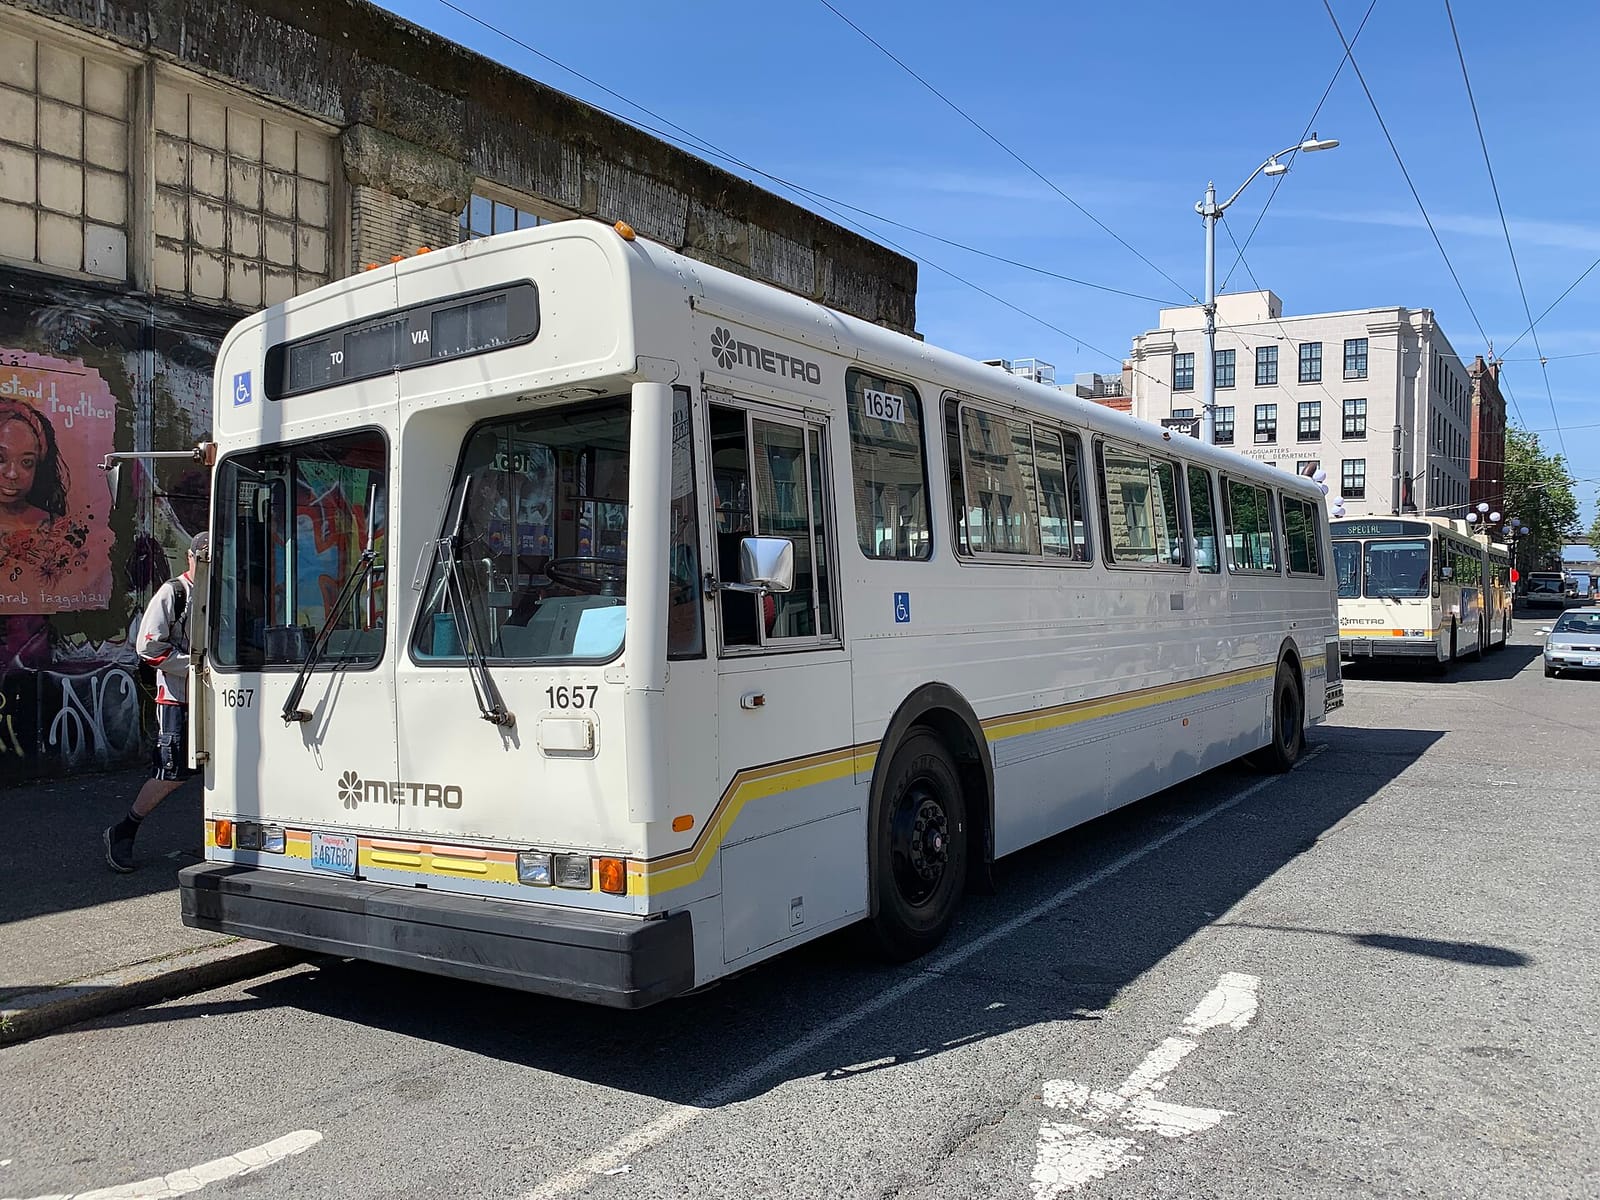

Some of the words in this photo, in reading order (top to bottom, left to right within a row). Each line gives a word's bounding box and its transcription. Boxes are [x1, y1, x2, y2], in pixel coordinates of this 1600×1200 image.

[411, 329, 430, 345] VIA
[330, 351, 344, 365] TO
[735, 341, 821, 385] METRO
[0, 374, 42, 399] stand
[48, 382, 112, 428] together
[866, 391, 902, 421] 1657
[1241, 447, 1290, 456] HEADQUARTERS
[1251, 453, 1266, 461] FIRE
[1272, 451, 1317, 460] DEPARTMENT
[1347, 526, 1381, 535] SPECIAL
[1349, 618, 1385, 626] METRO
[221, 688, 255, 708] 1657
[545, 685, 599, 709] 1657
[363, 780, 463, 809] METRO
